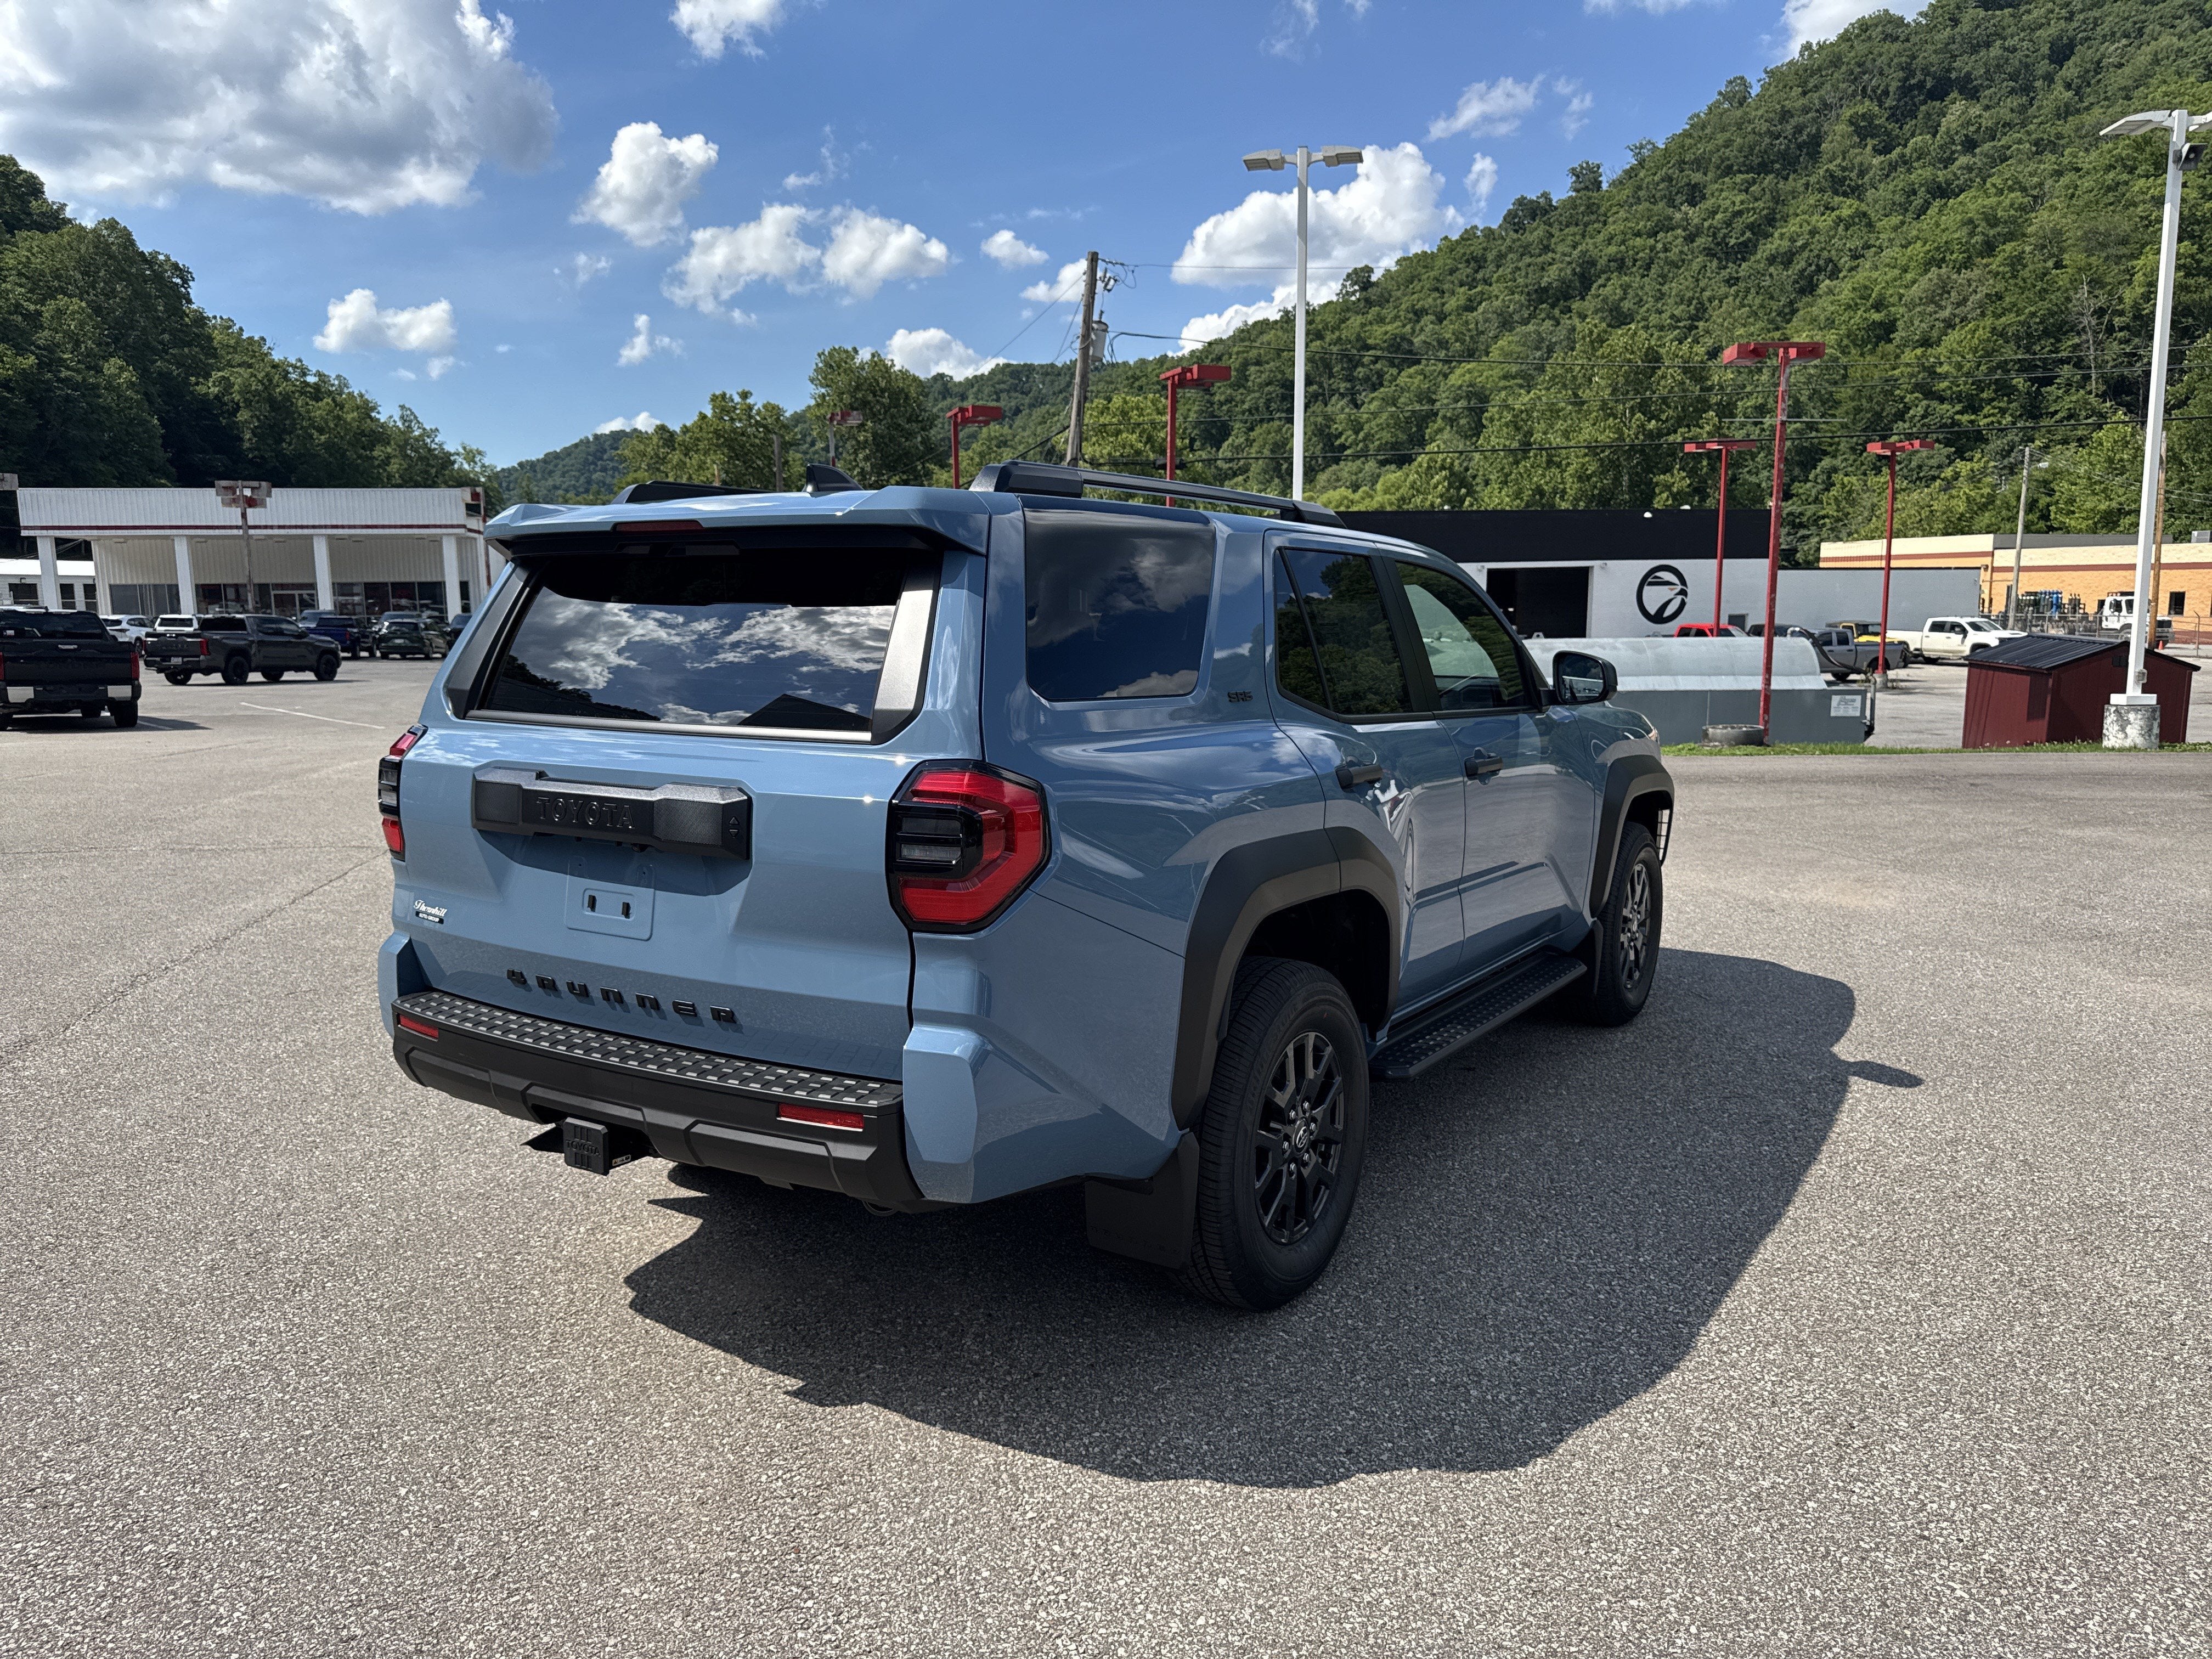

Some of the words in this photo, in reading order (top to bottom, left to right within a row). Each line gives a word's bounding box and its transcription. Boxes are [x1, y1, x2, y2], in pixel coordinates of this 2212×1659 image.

[1227, 691, 1253, 703] SR5
[537, 797, 635, 829] TOYOTA
[413, 899, 448, 917] Thornhill
[506, 968, 738, 1024] 4RUNNER
[566, 1139, 601, 1158] TOYOTA
